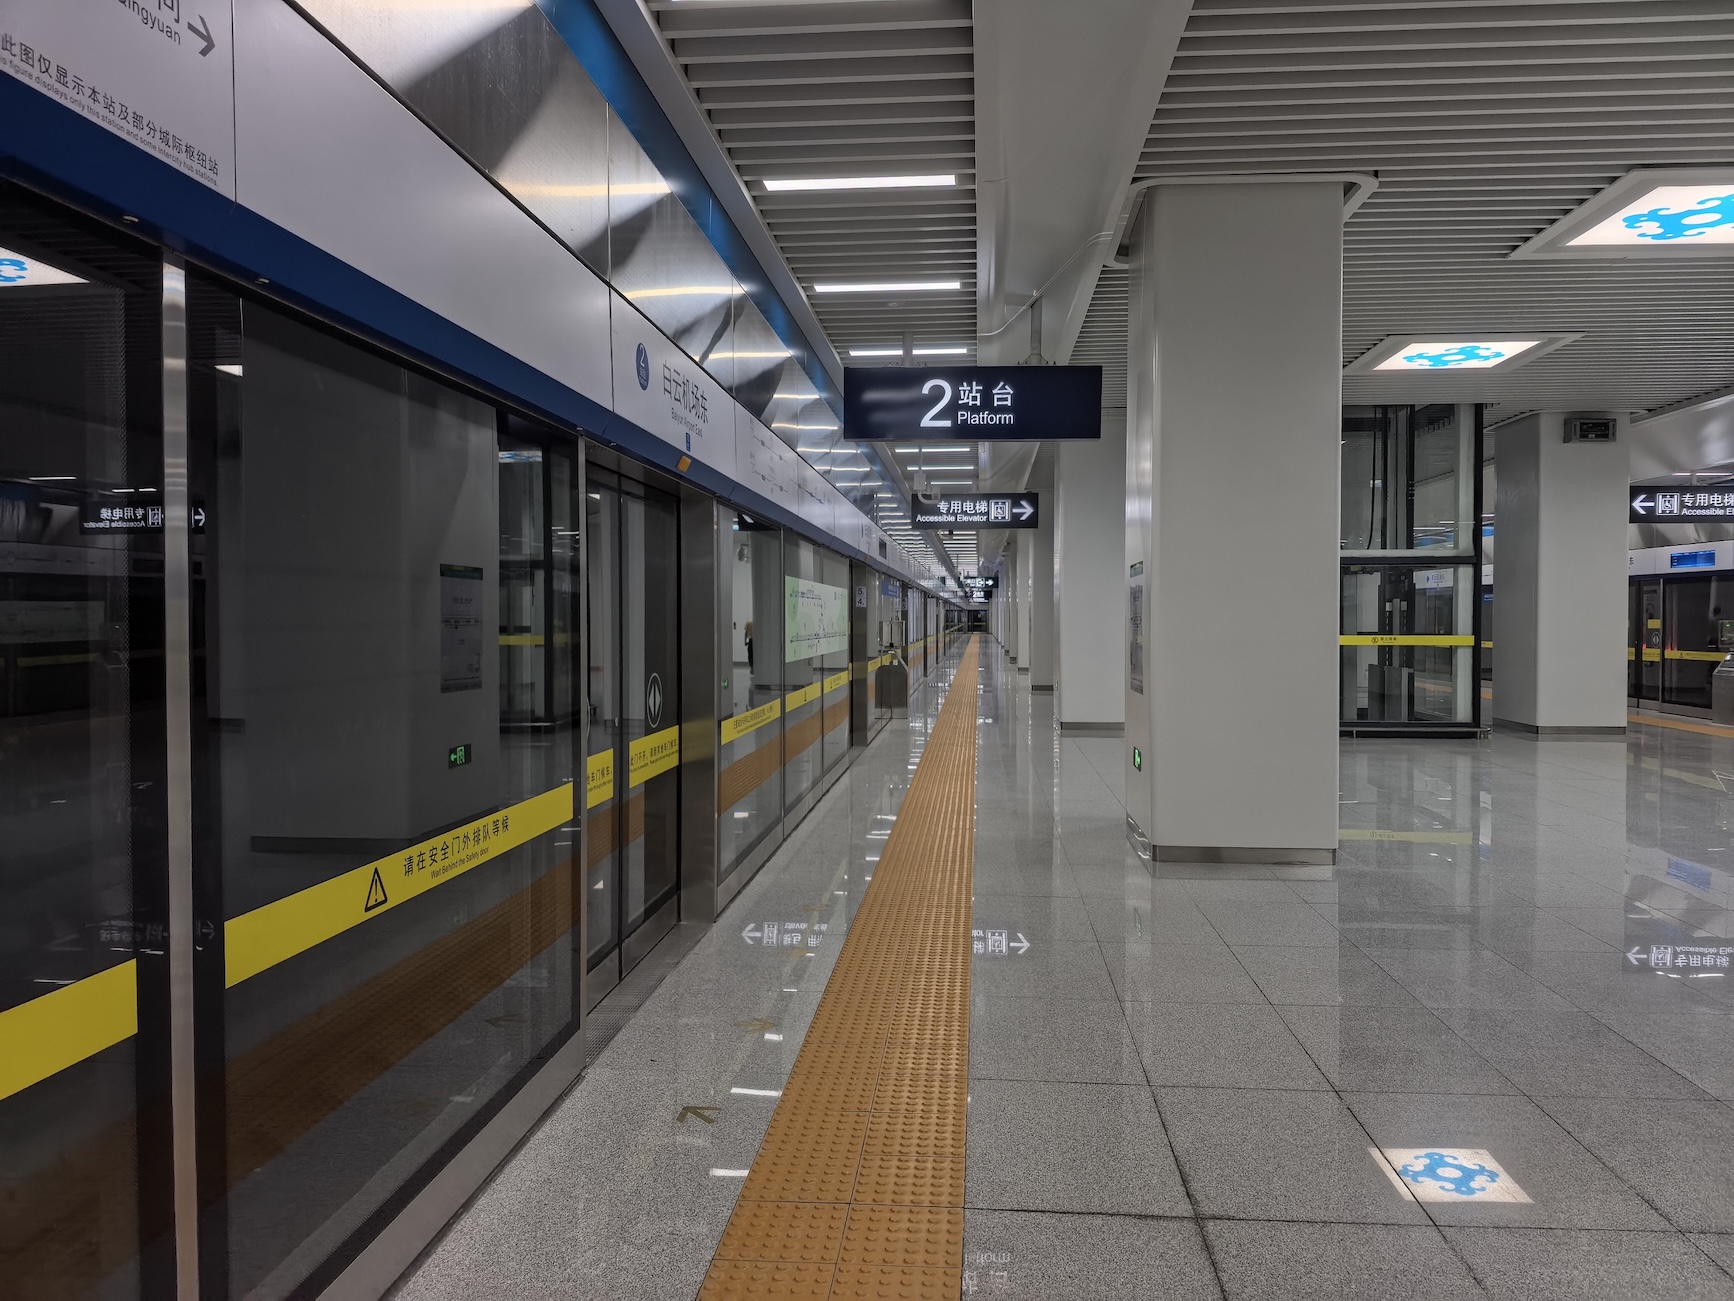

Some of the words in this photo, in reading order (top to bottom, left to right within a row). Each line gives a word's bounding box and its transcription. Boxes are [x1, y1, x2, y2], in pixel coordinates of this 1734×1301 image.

[1, 33, 219, 177] 此图仅显示本站及部分城际枢纽站
[9, 59, 34, 80] figure
[34, 75, 68, 101] displays
[69, 96, 86, 112] only
[101, 114, 125, 133] station
[126, 127, 139, 141] and
[139, 136, 157, 152] some
[157, 146, 182, 168] intercity
[183, 161, 194, 173] hub
[639, 344, 646, 368] 2
[662, 359, 709, 424] 白云机场东
[920, 378, 952, 427] 2
[958, 381, 1014, 406] 站台
[957, 411, 1014, 425] Platform
[937, 500, 988, 514] 专用电梯
[1681, 493, 1734, 507] 专用电梯
[1681, 507, 1725, 516] Accessible
[915, 514, 956, 522] Accessible
[956, 514, 988, 522] Elevator
[403, 815, 510, 877] 请在安全门外排队等候
